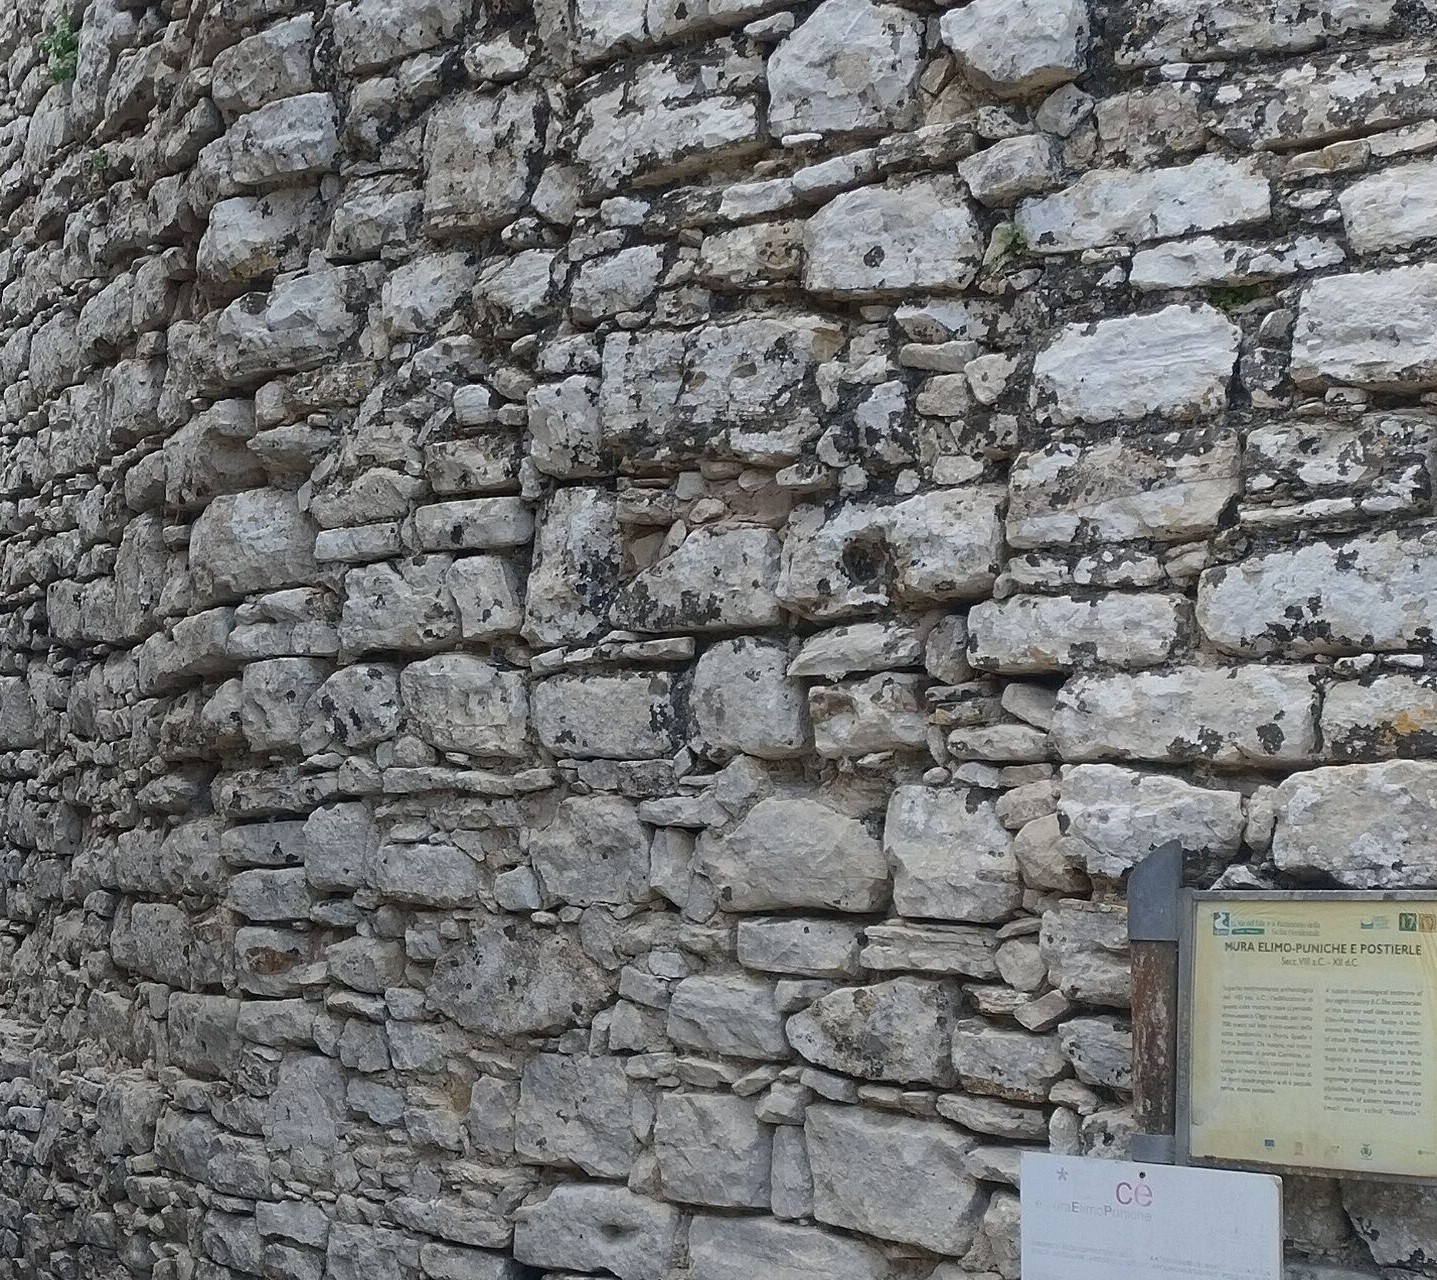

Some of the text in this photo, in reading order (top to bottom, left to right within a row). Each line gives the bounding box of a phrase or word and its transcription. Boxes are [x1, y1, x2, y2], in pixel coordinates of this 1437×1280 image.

[1224, 941, 1422, 956] MURA ELIMO-PUNICHE E POSTIERLE
